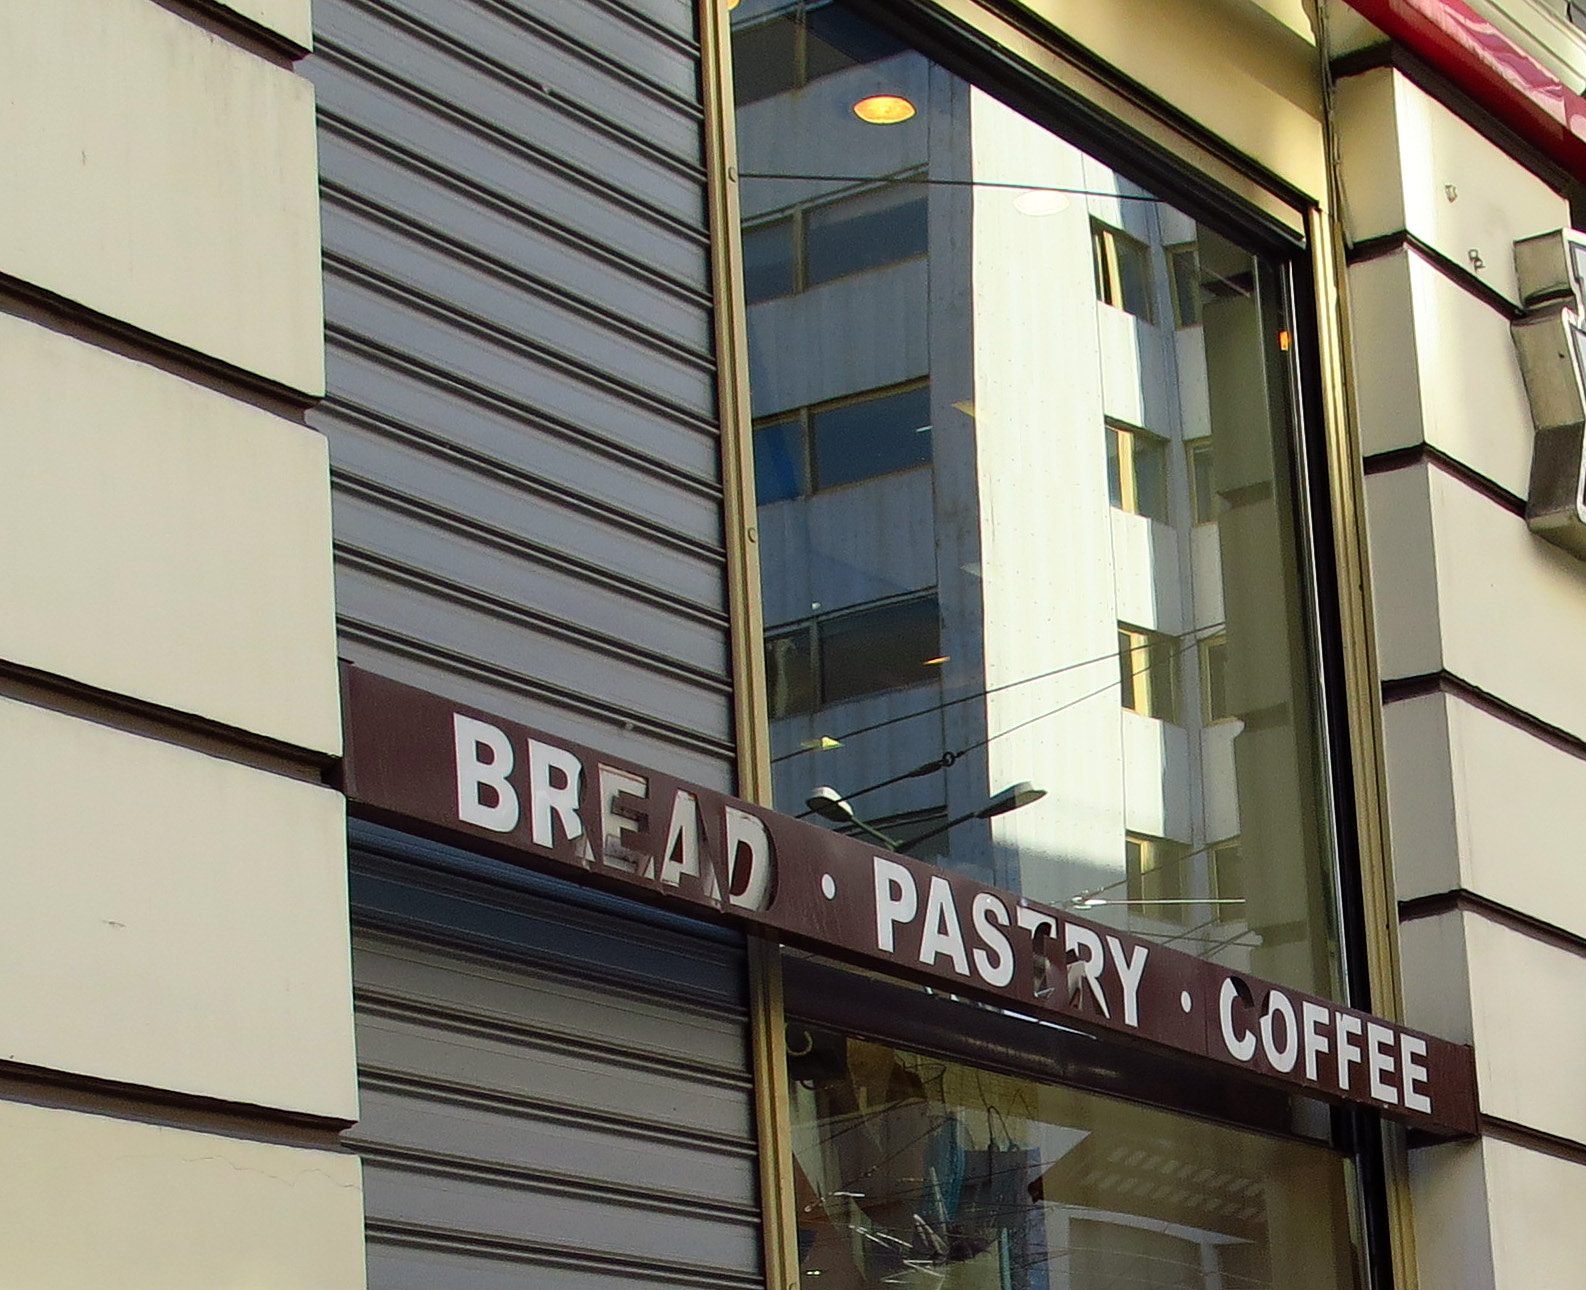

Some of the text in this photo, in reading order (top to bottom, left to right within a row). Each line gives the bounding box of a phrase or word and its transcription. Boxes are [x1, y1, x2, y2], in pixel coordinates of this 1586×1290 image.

[453, 711, 1433, 1115] BREAD PASTRY COFFEE
